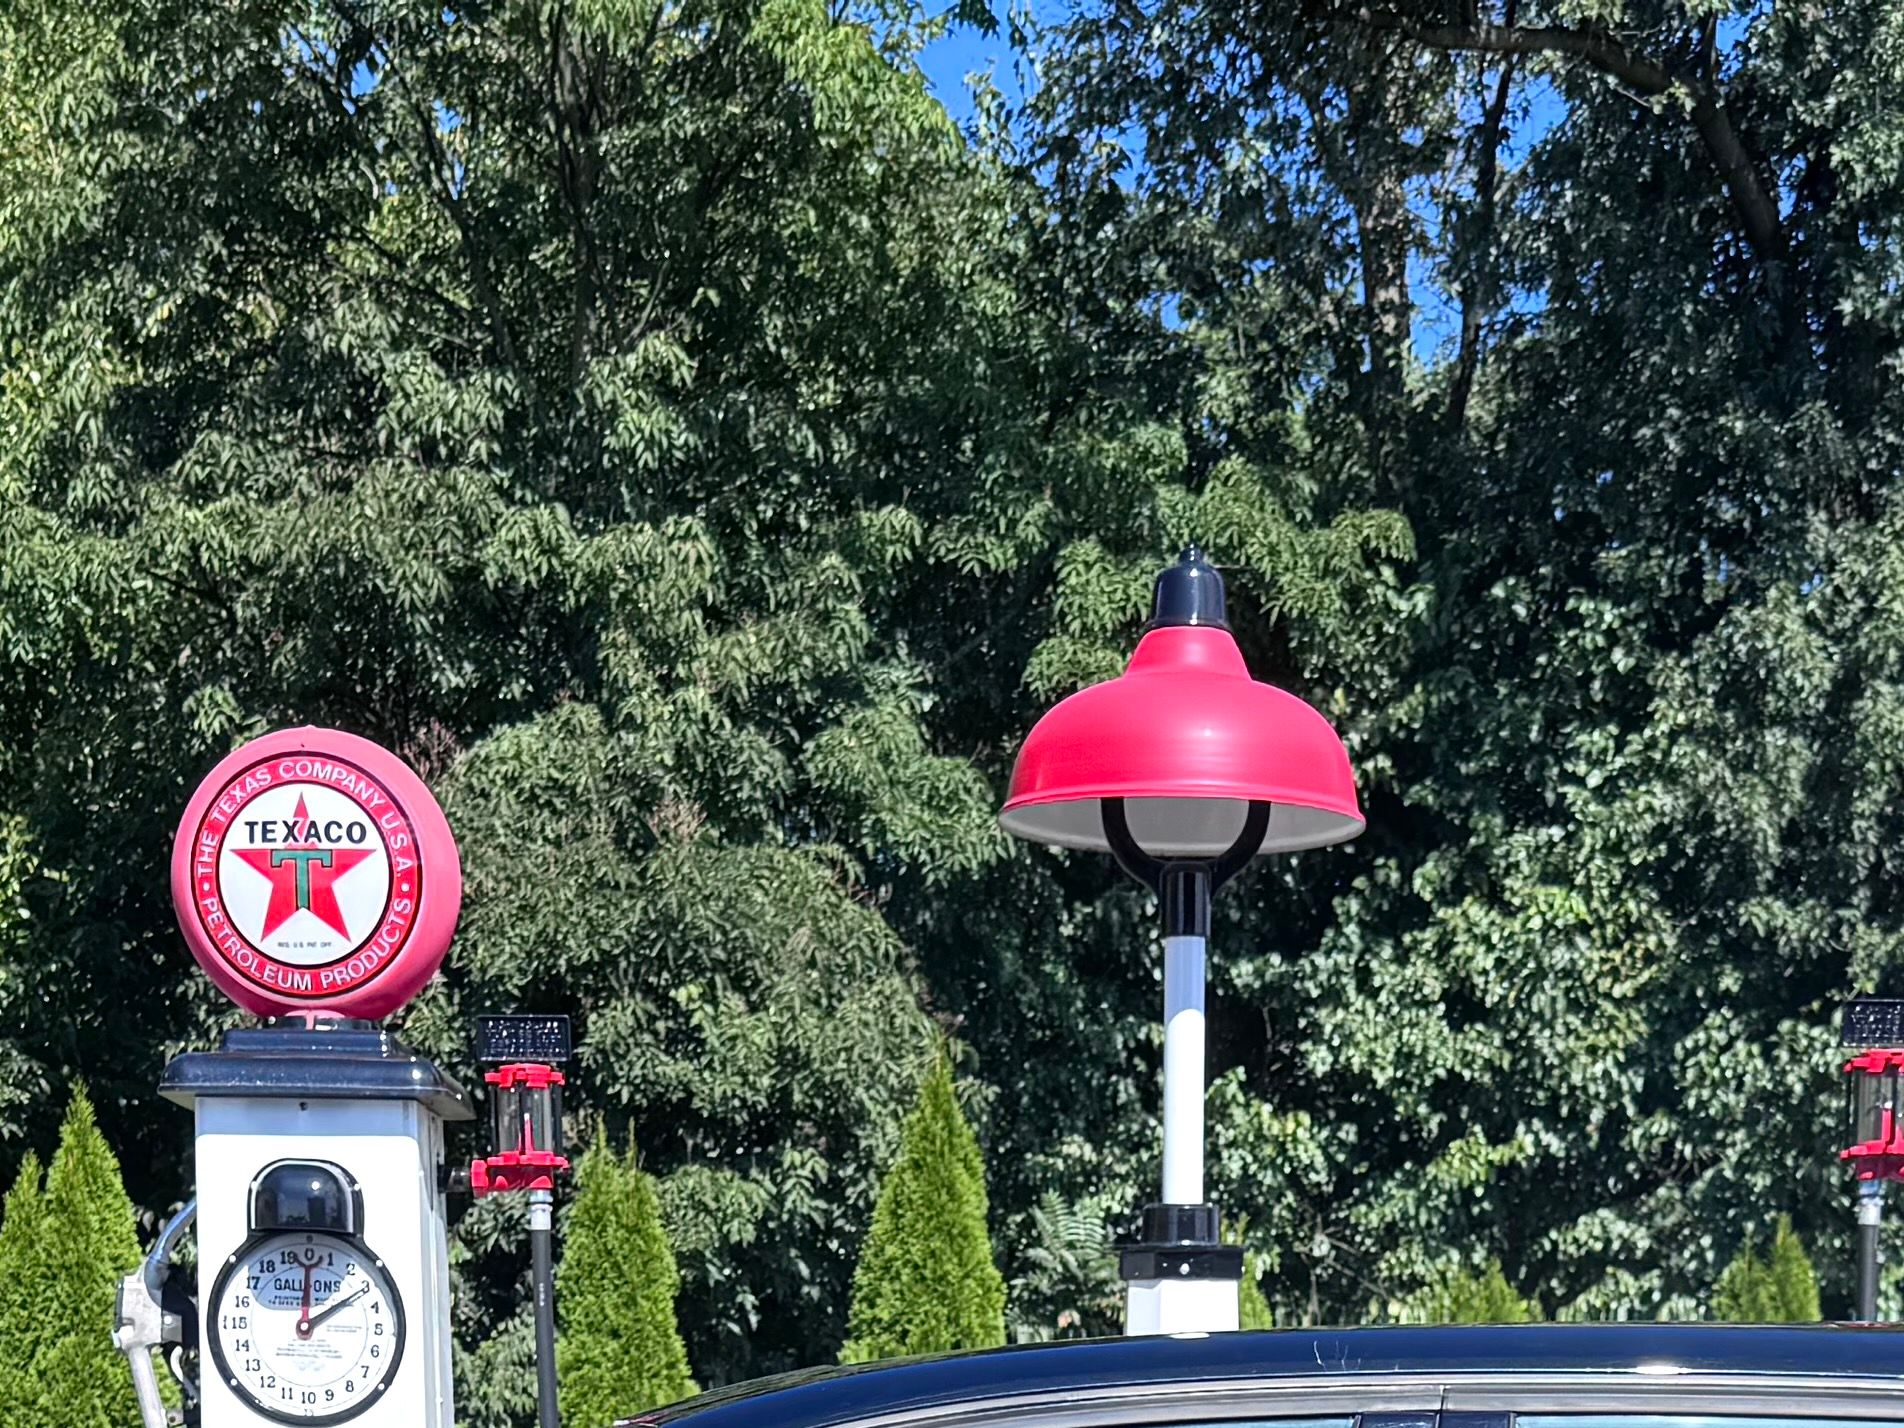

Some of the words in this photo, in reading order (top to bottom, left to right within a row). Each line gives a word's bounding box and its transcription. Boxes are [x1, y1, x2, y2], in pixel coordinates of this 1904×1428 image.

[198, 829, 219, 878] THE
[211, 768, 272, 822] TEXAS
[279, 760, 385, 811] COMPANY
[244, 819, 367, 844] TEXACO
[270, 849, 333, 911] T
[202, 899, 311, 990] PETROLEUM
[320, 898, 410, 988] PRODUCTS
[305, 1248, 314, 1261] 0
[328, 1252, 334, 1266] 1
[259, 1260, 275, 1273] 18
[346, 1263, 355, 1276] 2
[235, 1296, 249, 1308] 16
[371, 1301, 379, 1314] 4
[232, 1317, 247, 1329] 15
[374, 1323, 383, 1336] 5
[235, 1339, 249, 1351] 14
[371, 1345, 379, 1357] 6
[245, 1359, 260, 1372] 13
[361, 1366, 369, 1378] 7
[260, 1376, 275, 1388] 12
[346, 1380, 354, 1392] 8
[281, 1388, 293, 1400] 11
[301, 1392, 316, 1404] 10
[325, 1389, 334, 1401] 9
